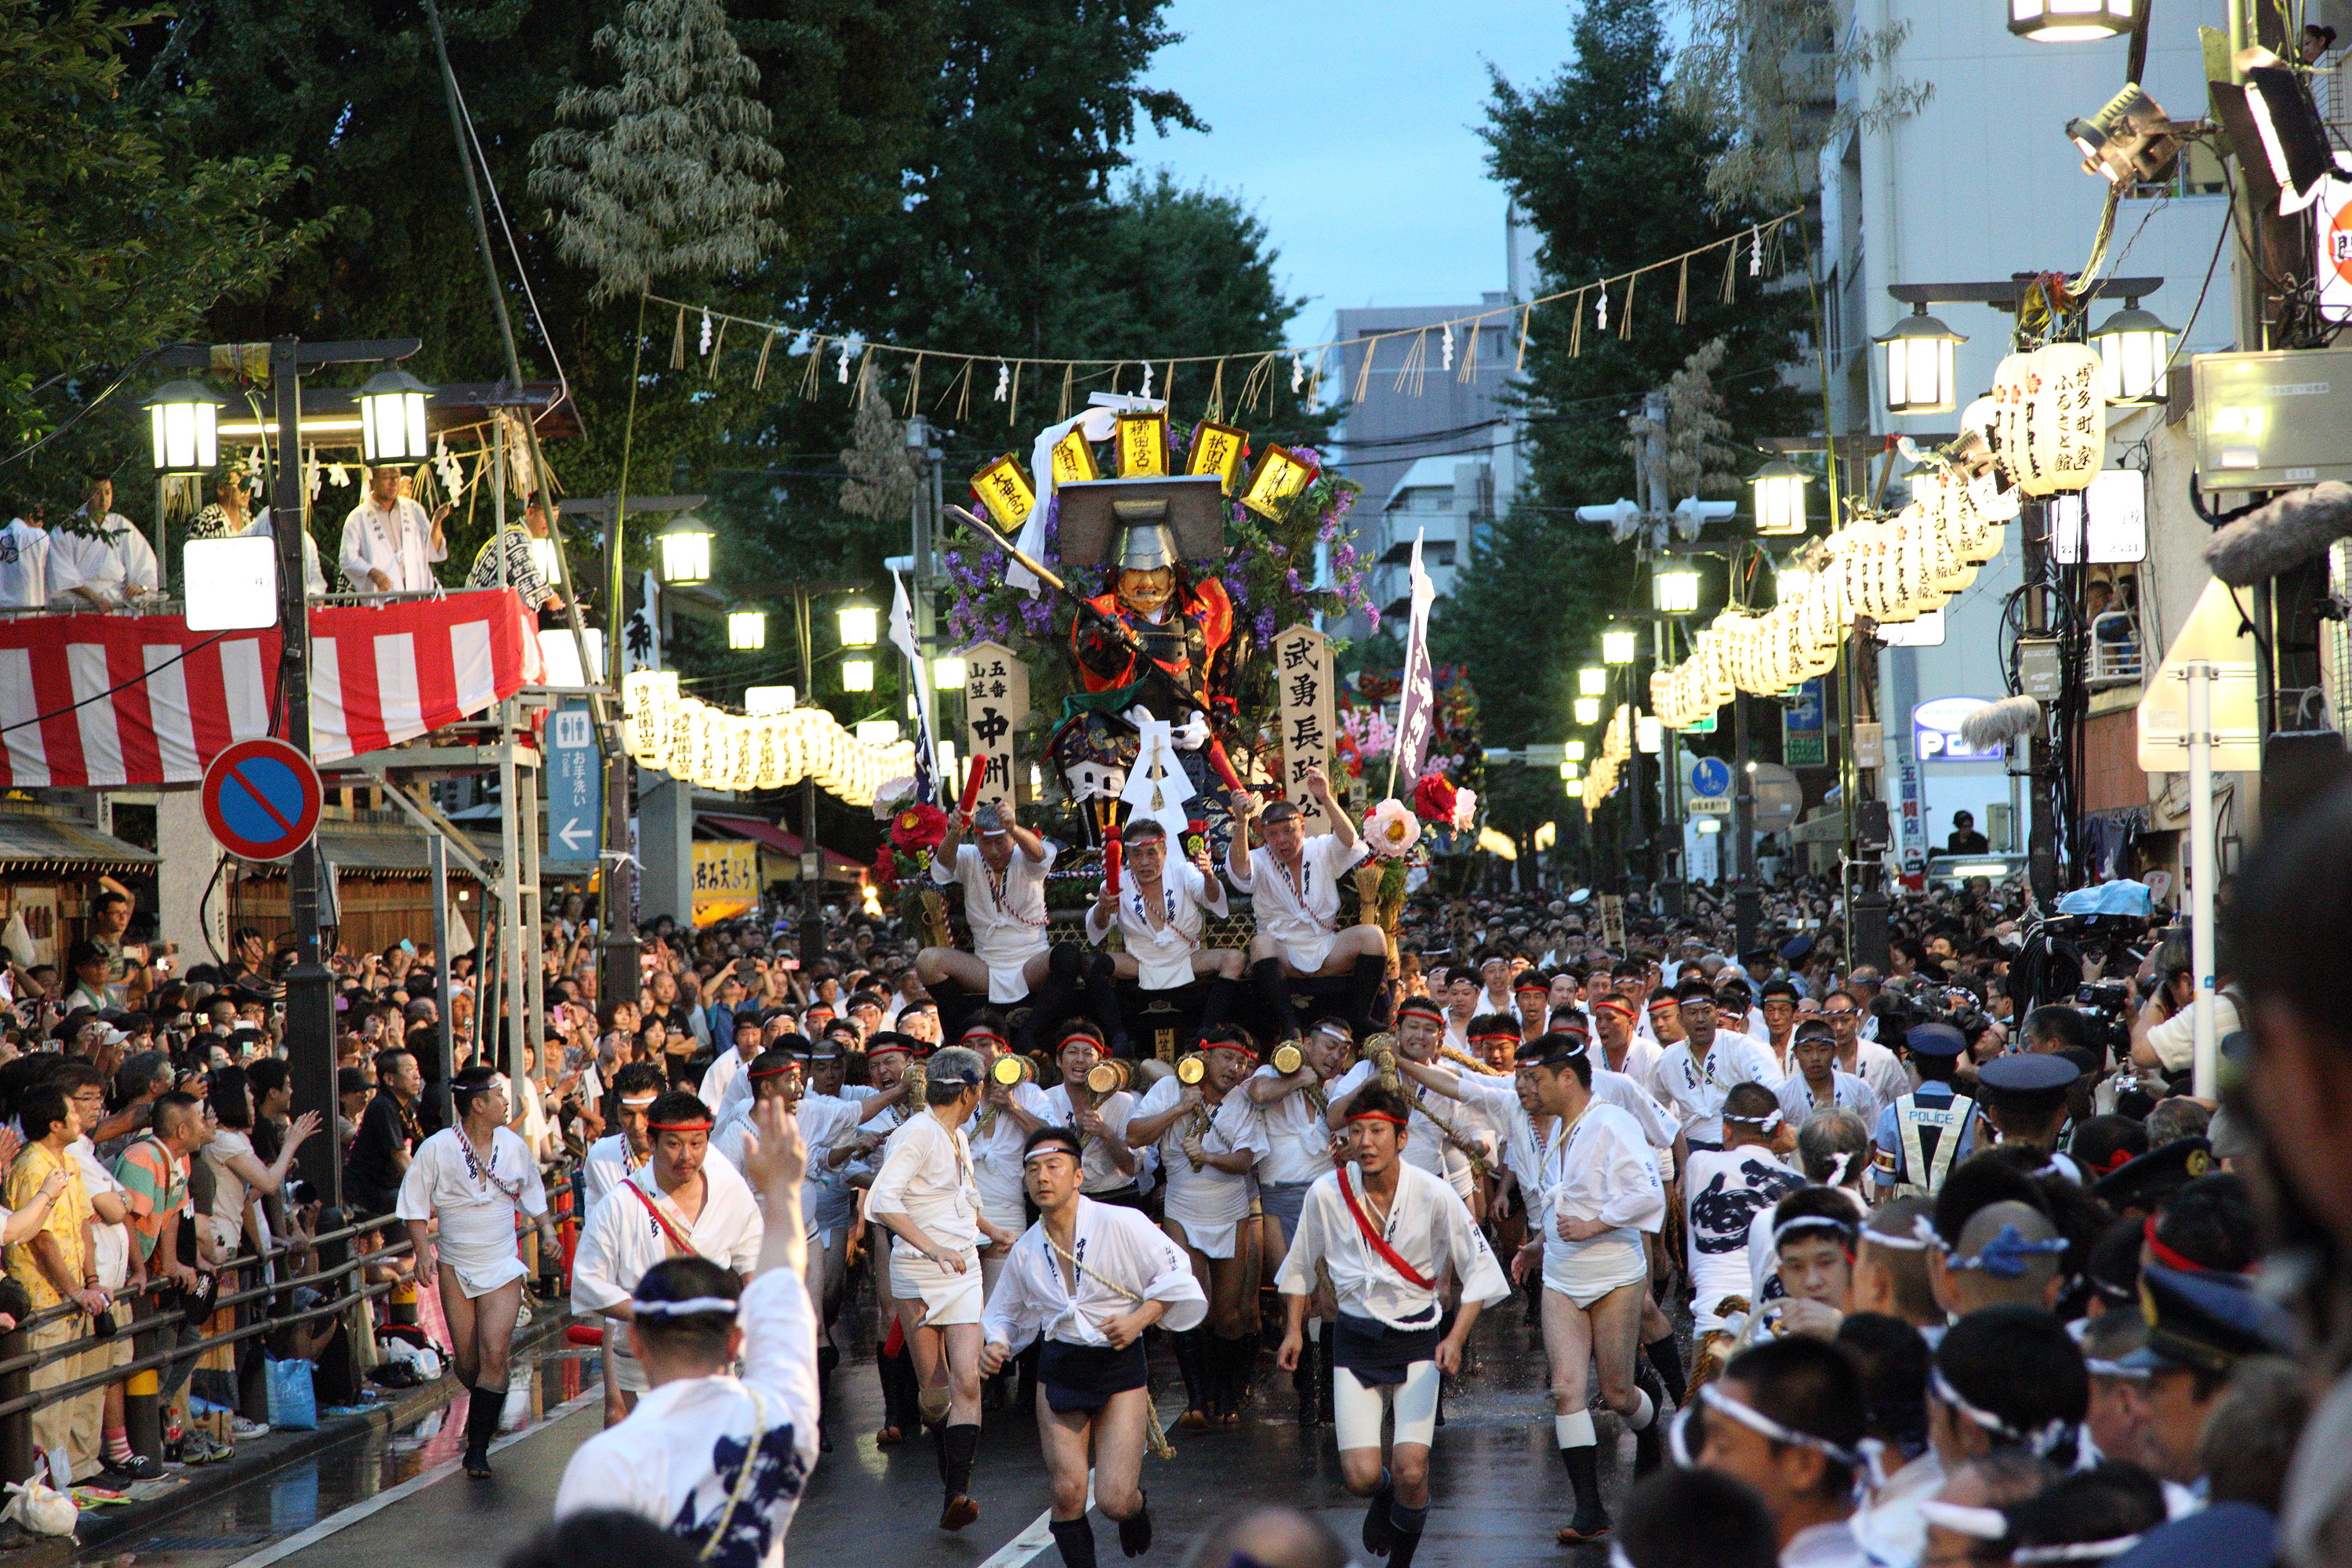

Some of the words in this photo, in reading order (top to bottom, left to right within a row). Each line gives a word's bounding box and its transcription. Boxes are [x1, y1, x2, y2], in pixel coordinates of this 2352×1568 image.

[1130, 420, 1150, 468] 櫛田宮
[2054, 375, 2074, 472] ふるさと館
[969, 662, 988, 699] 山笠
[988, 660, 1007, 699] 五番
[573, 751, 586, 808] お手洗い
[1909, 1111, 1954, 1124] POLICE
